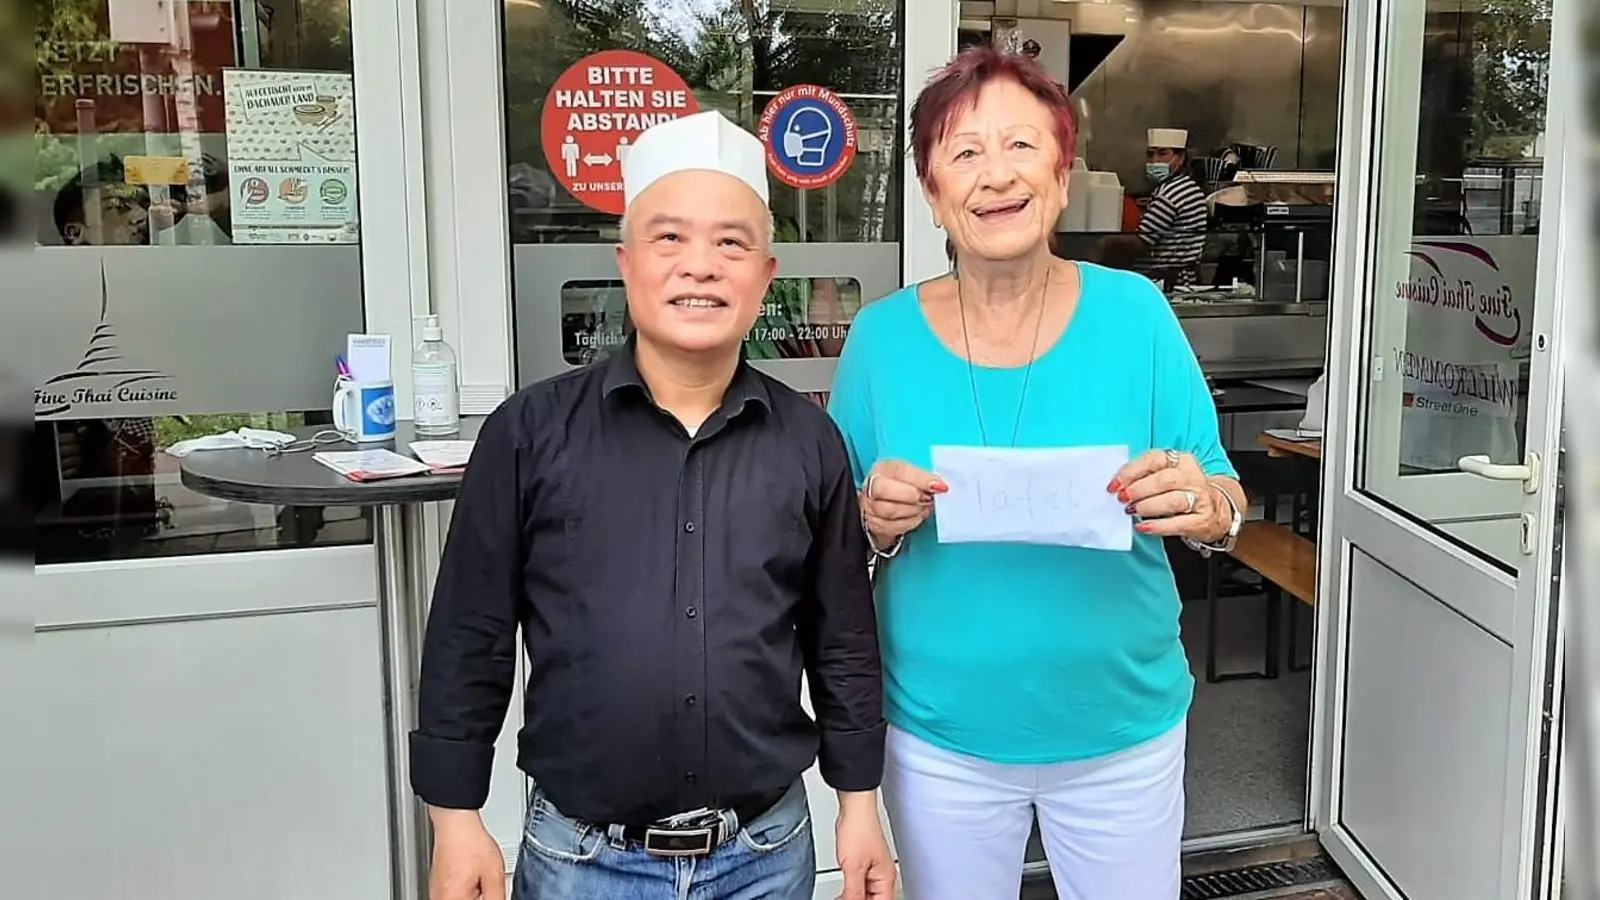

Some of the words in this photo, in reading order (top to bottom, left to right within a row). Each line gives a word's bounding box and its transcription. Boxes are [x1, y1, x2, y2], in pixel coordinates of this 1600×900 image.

[588, 66, 653, 85] BITTE
[41, 74, 221, 96] ERFRISCHEN.
[292, 92, 315, 104] LAND
[555, 90, 645, 108] HALTEN
[651, 90, 687, 108] SIE
[759, 126, 769, 142] Ab
[764, 102, 779, 124] hier
[779, 90, 795, 105] nur
[797, 86, 816, 96] mit
[572, 182, 586, 191] ZU
[574, 330, 618, 349] Täglich
[754, 327, 786, 341] 17:00
[797, 326, 829, 340] 22:00
[832, 325, 848, 339] Uh
[34, 388, 66, 405] Fine
[71, 388, 113, 404] Thai
[117, 387, 179, 402] Cuisine
[1416, 396, 1452, 412] Street
[1453, 402, 1478, 417] One
